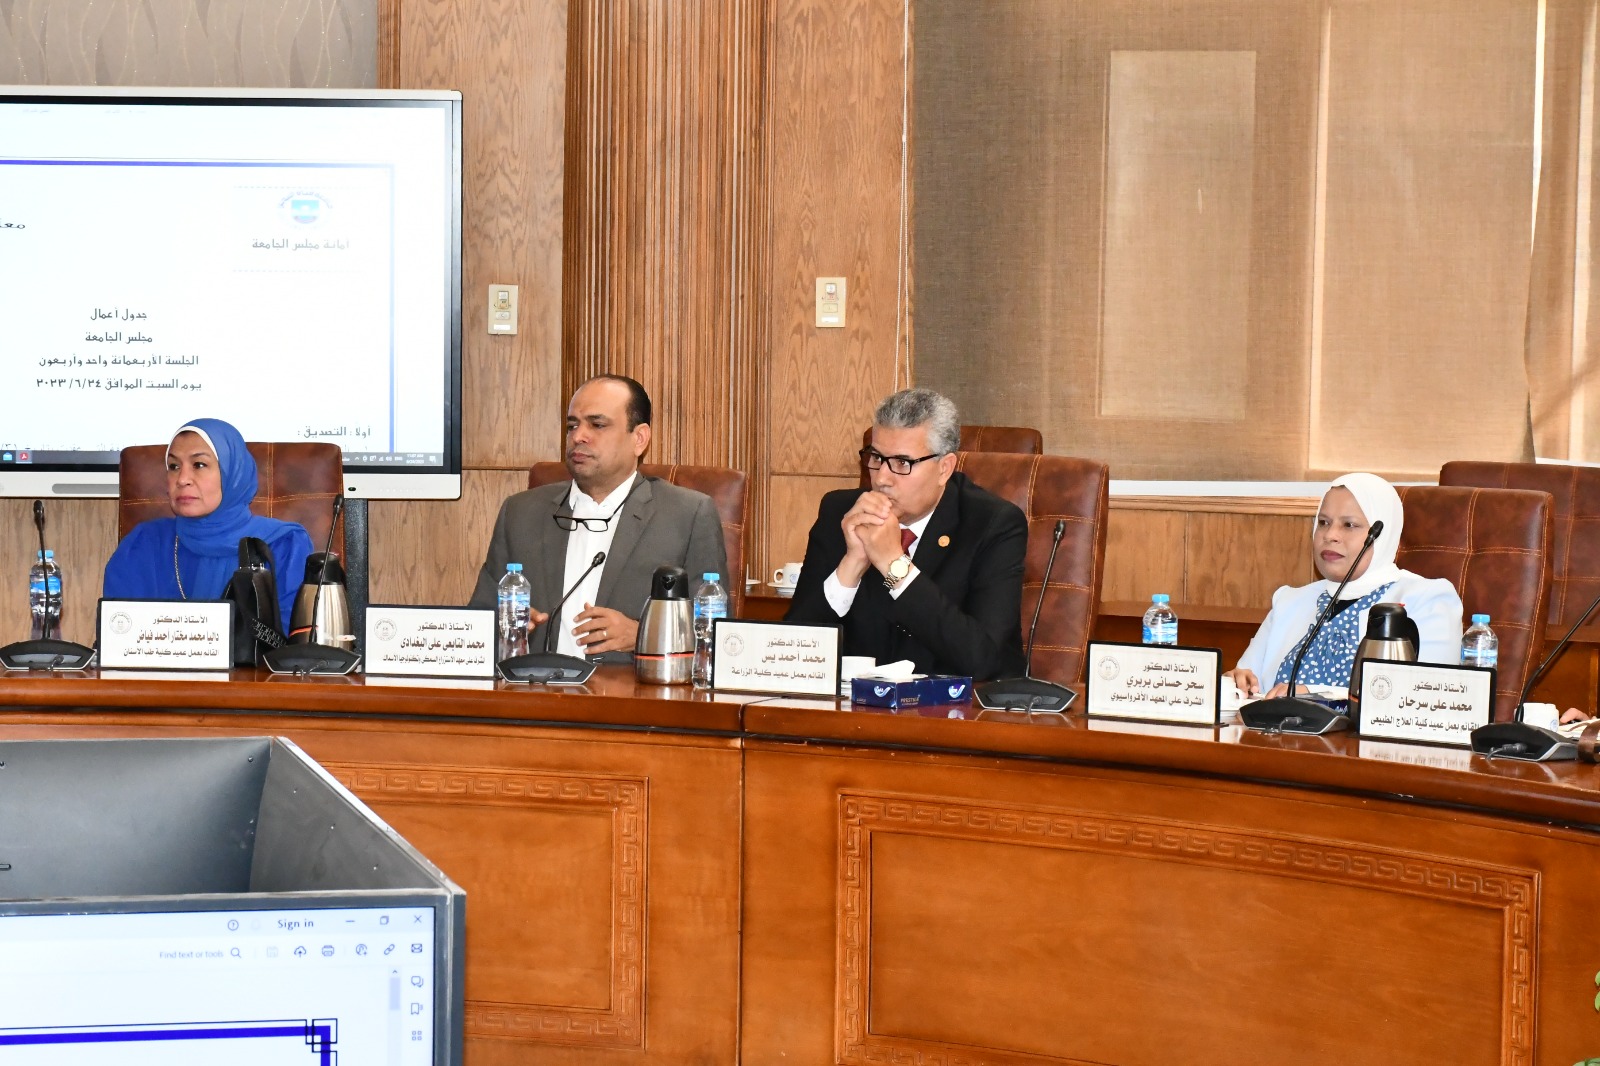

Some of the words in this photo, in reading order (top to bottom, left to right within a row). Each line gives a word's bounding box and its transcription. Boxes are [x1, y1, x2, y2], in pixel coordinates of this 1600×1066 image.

[252, 238, 289, 251] الجامعة
[292, 238, 320, 252] مجلس
[121, 308, 148, 321] جدول
[85, 331, 122, 344] الجامعة
[125, 331, 153, 344] مجلس
[85, 354, 108, 367] واحد
[165, 354, 199, 367] الجلسة
[104, 378, 143, 391] الموافق
[145, 378, 179, 391] السبت
[180, 381, 202, 392] يوم
[303, 425, 347, 439] التصديق
[152, 615, 183, 625] الدكتور
[417, 622, 448, 632] الدكتور
[171, 630, 188, 644] مختار
[188, 631, 206, 641] محمد
[466, 639, 485, 649] محمد
[767, 637, 795, 648] الدكتور
[796, 637, 820, 648] الأستاذ
[155, 647, 172, 658] كلية
[172, 648, 187, 658] عميد
[778, 651, 800, 662] أحمد
[802, 654, 826, 663] محمد
[731, 666, 753, 678] الزراعة
[1143, 661, 1173, 672] الدكتور
[1174, 662, 1198, 674] الأستاذ
[754, 667, 772, 678] كلية
[773, 670, 789, 680] عميد
[790, 670, 806, 681] بعمل
[1184, 681, 1204, 691] سحر
[1413, 681, 1443, 692] الدكتور
[1443, 682, 1468, 694] الأستاذ
[1398, 696, 1429, 711] سرحان
[1449, 701, 1473, 712] محمد
[1396, 716, 1414, 728] العلاج
[1415, 716, 1428, 730] كلية
[1428, 719, 1444, 731] عميد
[277, 918, 300, 931] Sign
[304, 918, 314, 928] in
[159, 950, 177, 960] Find
[179, 951, 194, 960] text
[195, 951, 203, 959] or
[205, 949, 224, 959] tools
